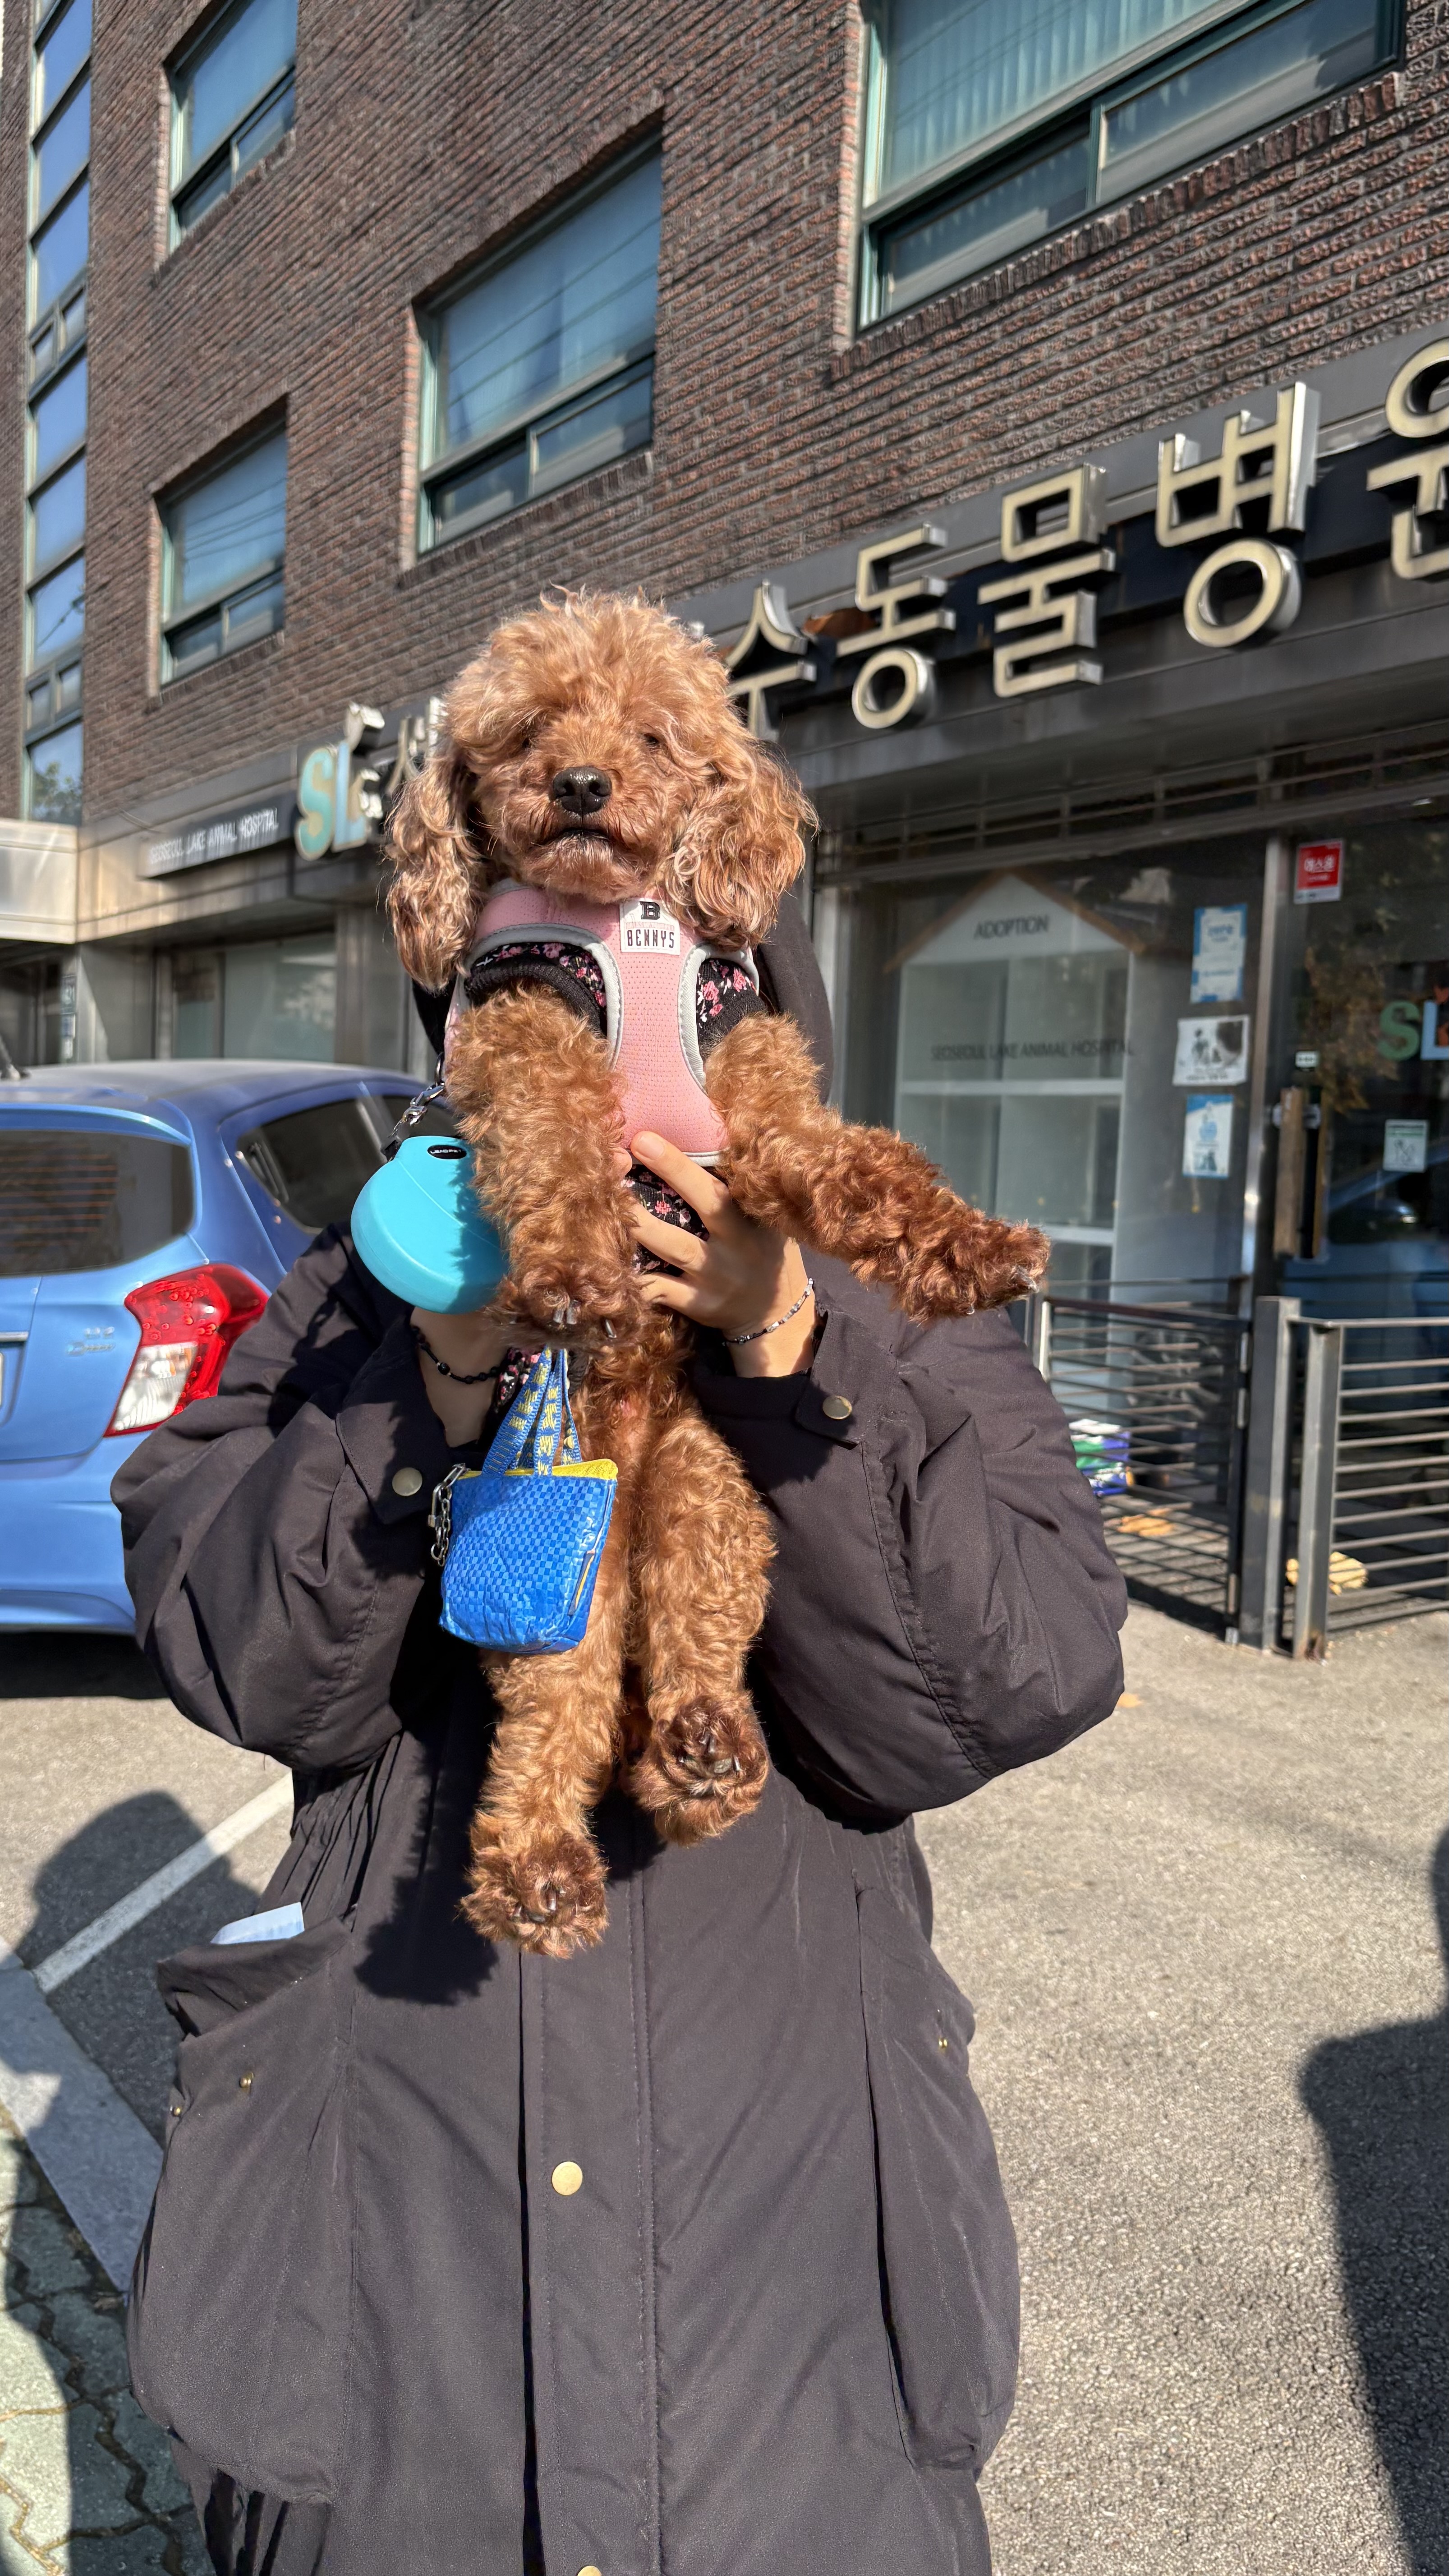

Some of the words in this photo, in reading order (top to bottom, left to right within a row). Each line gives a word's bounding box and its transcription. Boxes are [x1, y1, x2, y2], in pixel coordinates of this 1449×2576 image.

[208, 821, 238, 847] ANIMAL
[239, 807, 279, 839] HOSPITAL
[639, 901, 660, 920] B
[973, 914, 1049, 940] ADOPTION
[627, 929, 674, 948] BENNYS
[1020, 1041, 1070, 1058] ANIMAL
